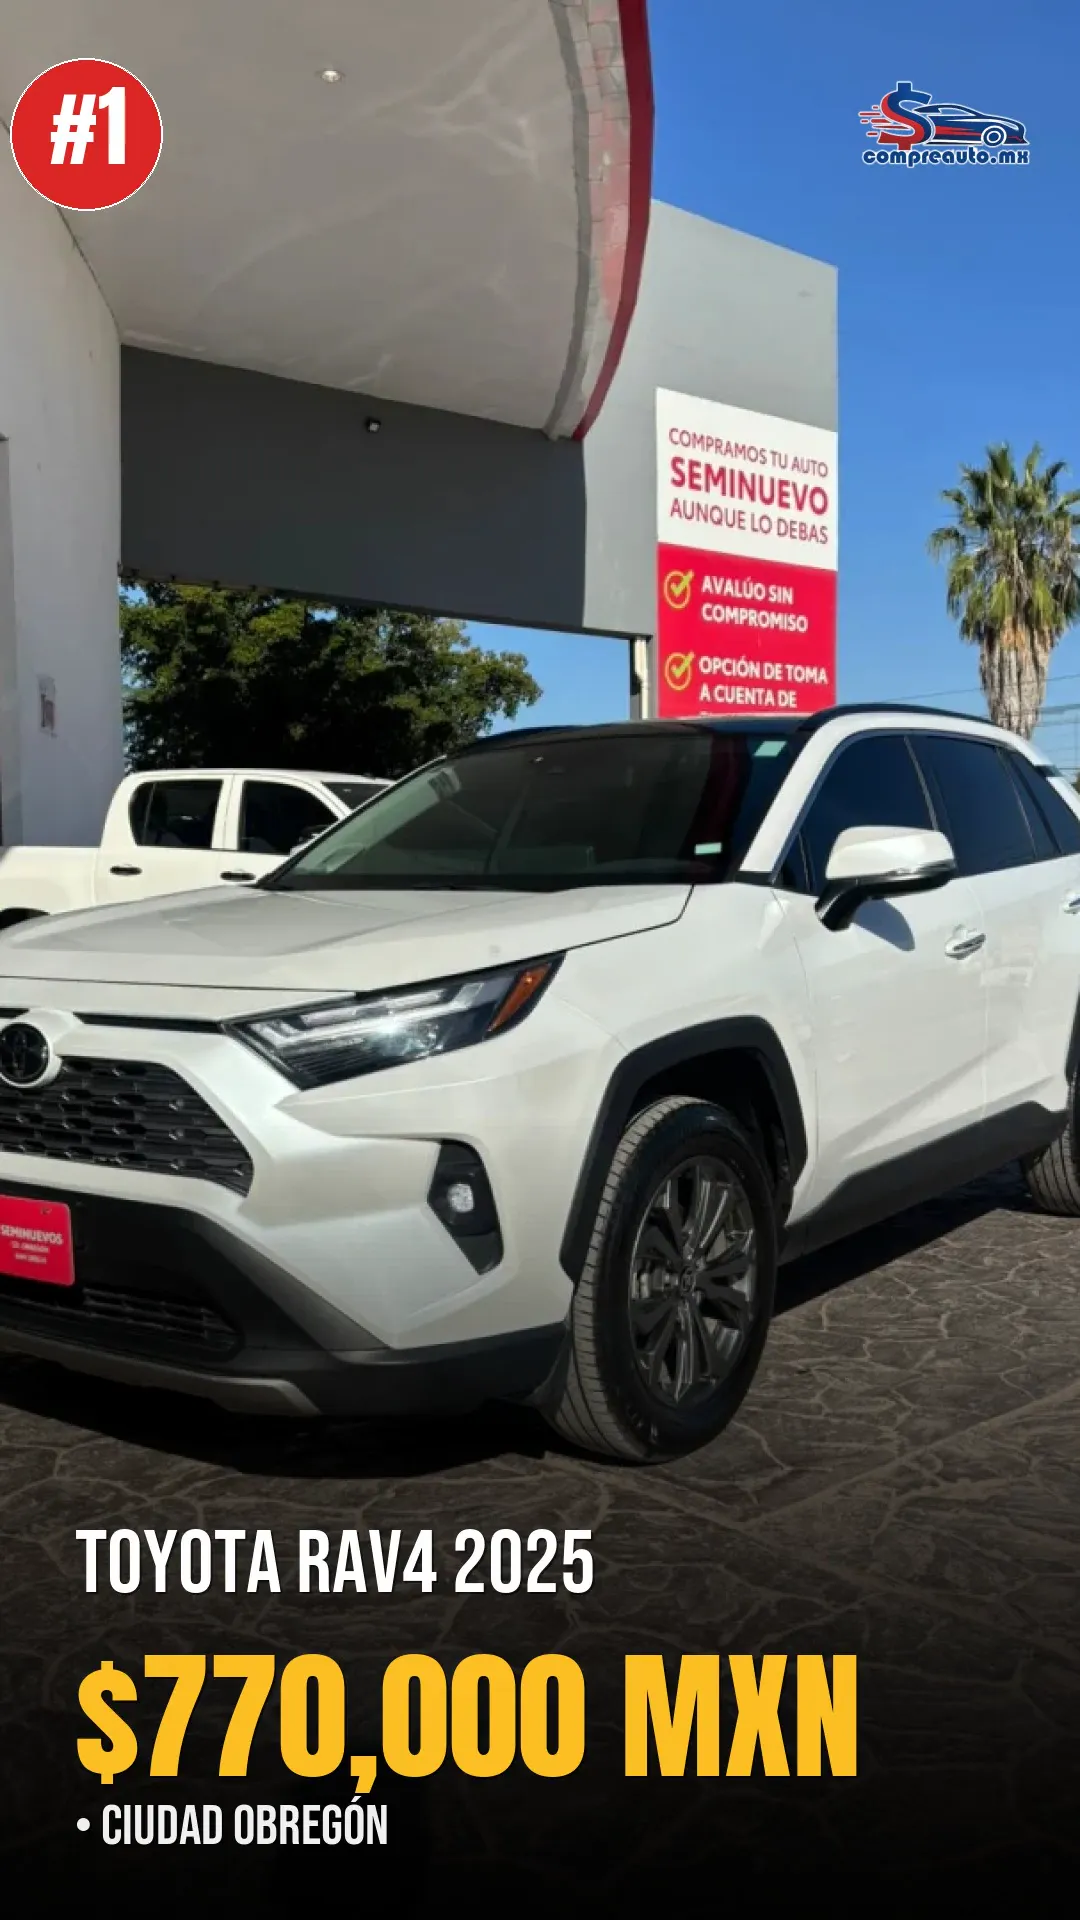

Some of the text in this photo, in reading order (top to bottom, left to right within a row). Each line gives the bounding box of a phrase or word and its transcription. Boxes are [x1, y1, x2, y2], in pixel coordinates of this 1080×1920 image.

[668, 428, 828, 478] COMPRAMOS TU AUTO
[670, 456, 828, 516] SEMINUEVO
[670, 498, 828, 545] AUNQUE LO DEBAS
[702, 574, 794, 605] AVALÚO SIN
[702, 603, 808, 633] COMPROMISO
[699, 654, 828, 685] OPCIÓN DE TOMA
[700, 683, 797, 708] A CUENTA DE
